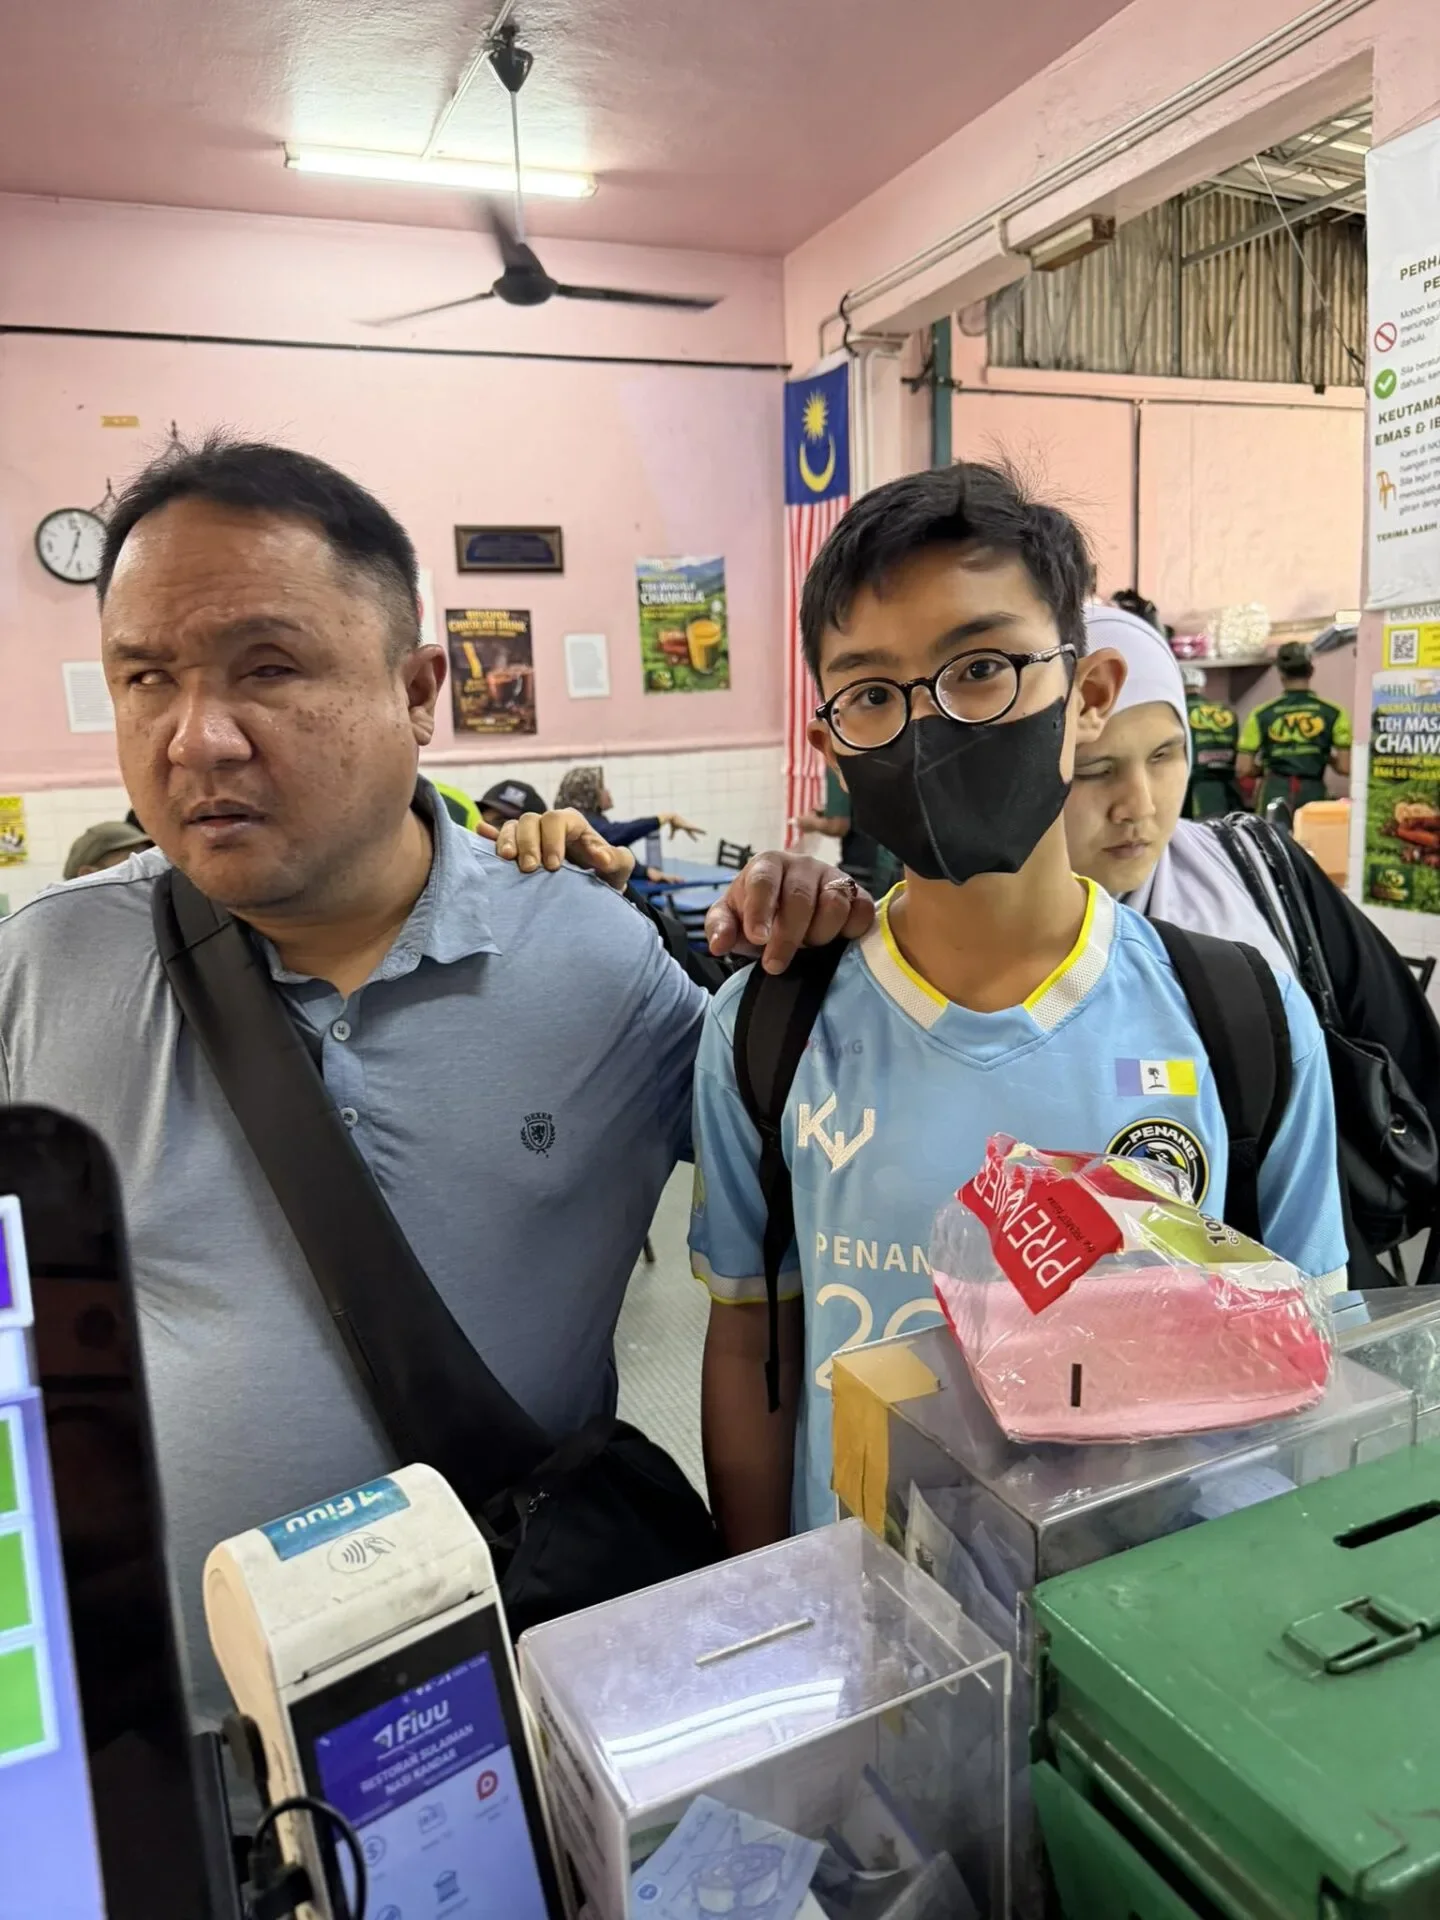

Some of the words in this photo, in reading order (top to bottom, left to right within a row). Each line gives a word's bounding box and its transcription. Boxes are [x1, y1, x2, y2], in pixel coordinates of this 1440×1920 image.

[1400, 255, 1440, 281] PERH
[1375, 426, 1412, 446] EMAS
[1376, 529, 1409, 543] TERIMA
[1377, 716, 1402, 732] TEH
[1404, 716, 1440, 733] MAS
[1375, 733, 1440, 753] CHAIW
[1128, 1125, 1199, 1161] PENANG
[973, 1163, 1082, 1289] PREMIER
[815, 1231, 934, 1276] PENAN
[285, 1495, 356, 1533] Fiuu
[396, 1699, 449, 1743] Fiuu
